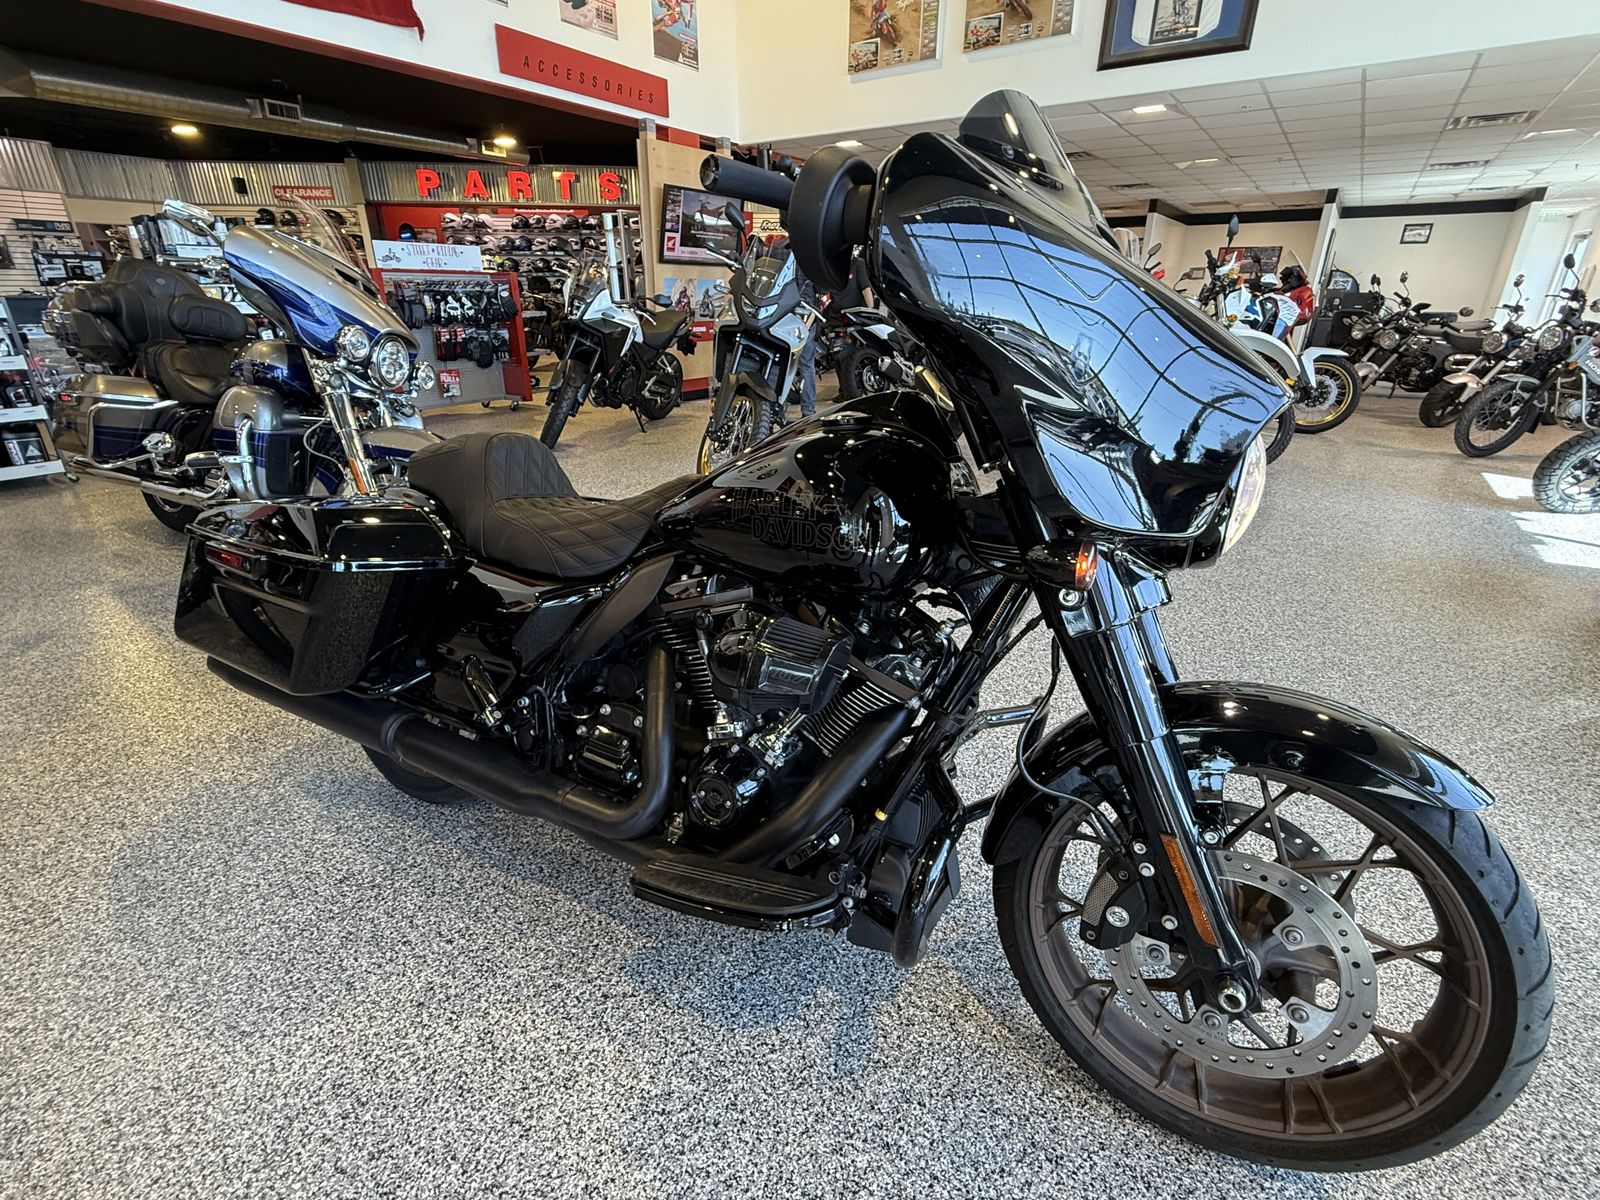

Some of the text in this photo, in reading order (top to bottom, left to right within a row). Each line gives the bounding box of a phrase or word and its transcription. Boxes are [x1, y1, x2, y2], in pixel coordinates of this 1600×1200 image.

[523, 56, 654, 104] ACCESSORIES
[274, 187, 333, 197] CLEARANCE
[415, 168, 622, 201] PARTS
[751, 515, 873, 554] DAVIDSON
